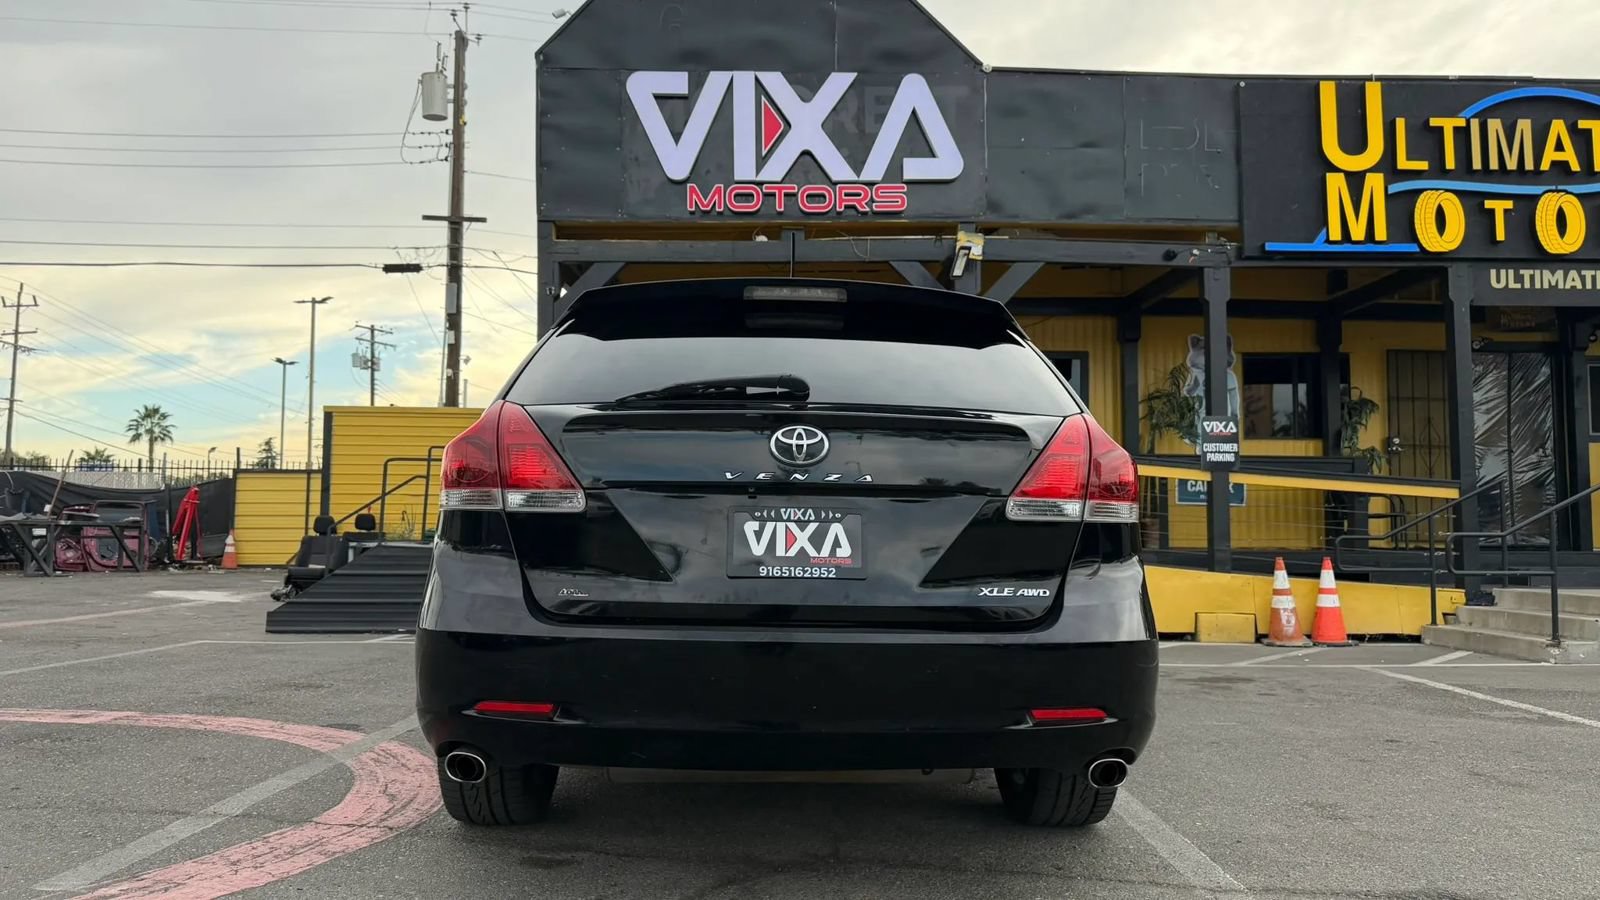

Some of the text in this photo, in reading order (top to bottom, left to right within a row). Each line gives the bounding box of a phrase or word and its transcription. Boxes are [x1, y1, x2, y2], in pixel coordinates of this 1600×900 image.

[626, 71, 964, 182] VIXA
[686, 183, 908, 213] MOTORS
[1203, 421, 1237, 432] VIXA
[1203, 443, 1238, 452] CUSTOMER
[1207, 453, 1235, 462] PARKING
[724, 472, 874, 482] VENZA
[780, 508, 815, 520] VIXA
[743, 521, 852, 557] VIXA
[759, 566, 836, 578] 9165162952
[978, 587, 1050, 596] XLE AWD
